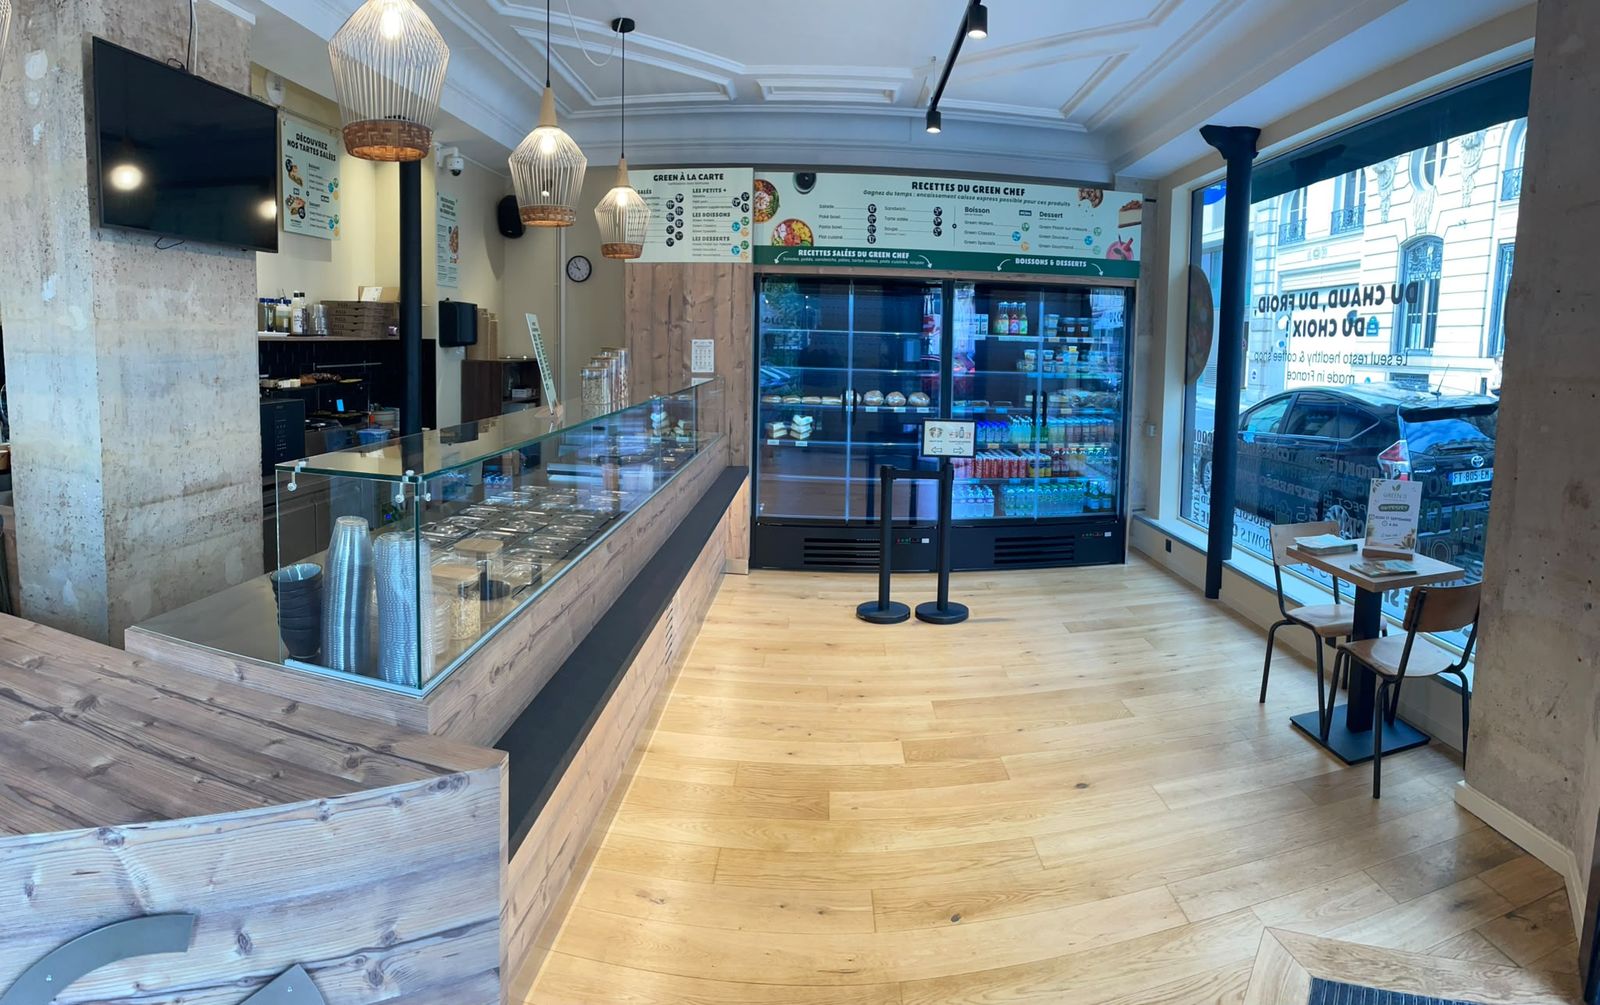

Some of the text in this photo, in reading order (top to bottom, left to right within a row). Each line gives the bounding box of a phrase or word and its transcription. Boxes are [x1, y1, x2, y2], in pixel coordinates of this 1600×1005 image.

[296, 132, 328, 150] DÉCOUVREZ
[287, 139, 299, 150] NOS
[299, 143, 319, 156] TARTES
[680, 172, 686, 181] À
[687, 173, 697, 181] LA
[698, 173, 724, 181] CARTE
[863, 189, 885, 197] Gagnez
[911, 181, 1026, 197] RECETTES DU GREEN CHEF
[964, 206, 990, 214] Boisson
[798, 249, 831, 257] RECETTES
[832, 248, 856, 257] SALÉES
[857, 250, 867, 258] DU
[892, 251, 910, 259] CHEF
[1015, 257, 1048, 266] BOISSONS
[1055, 260, 1087, 268] DESSERTS
